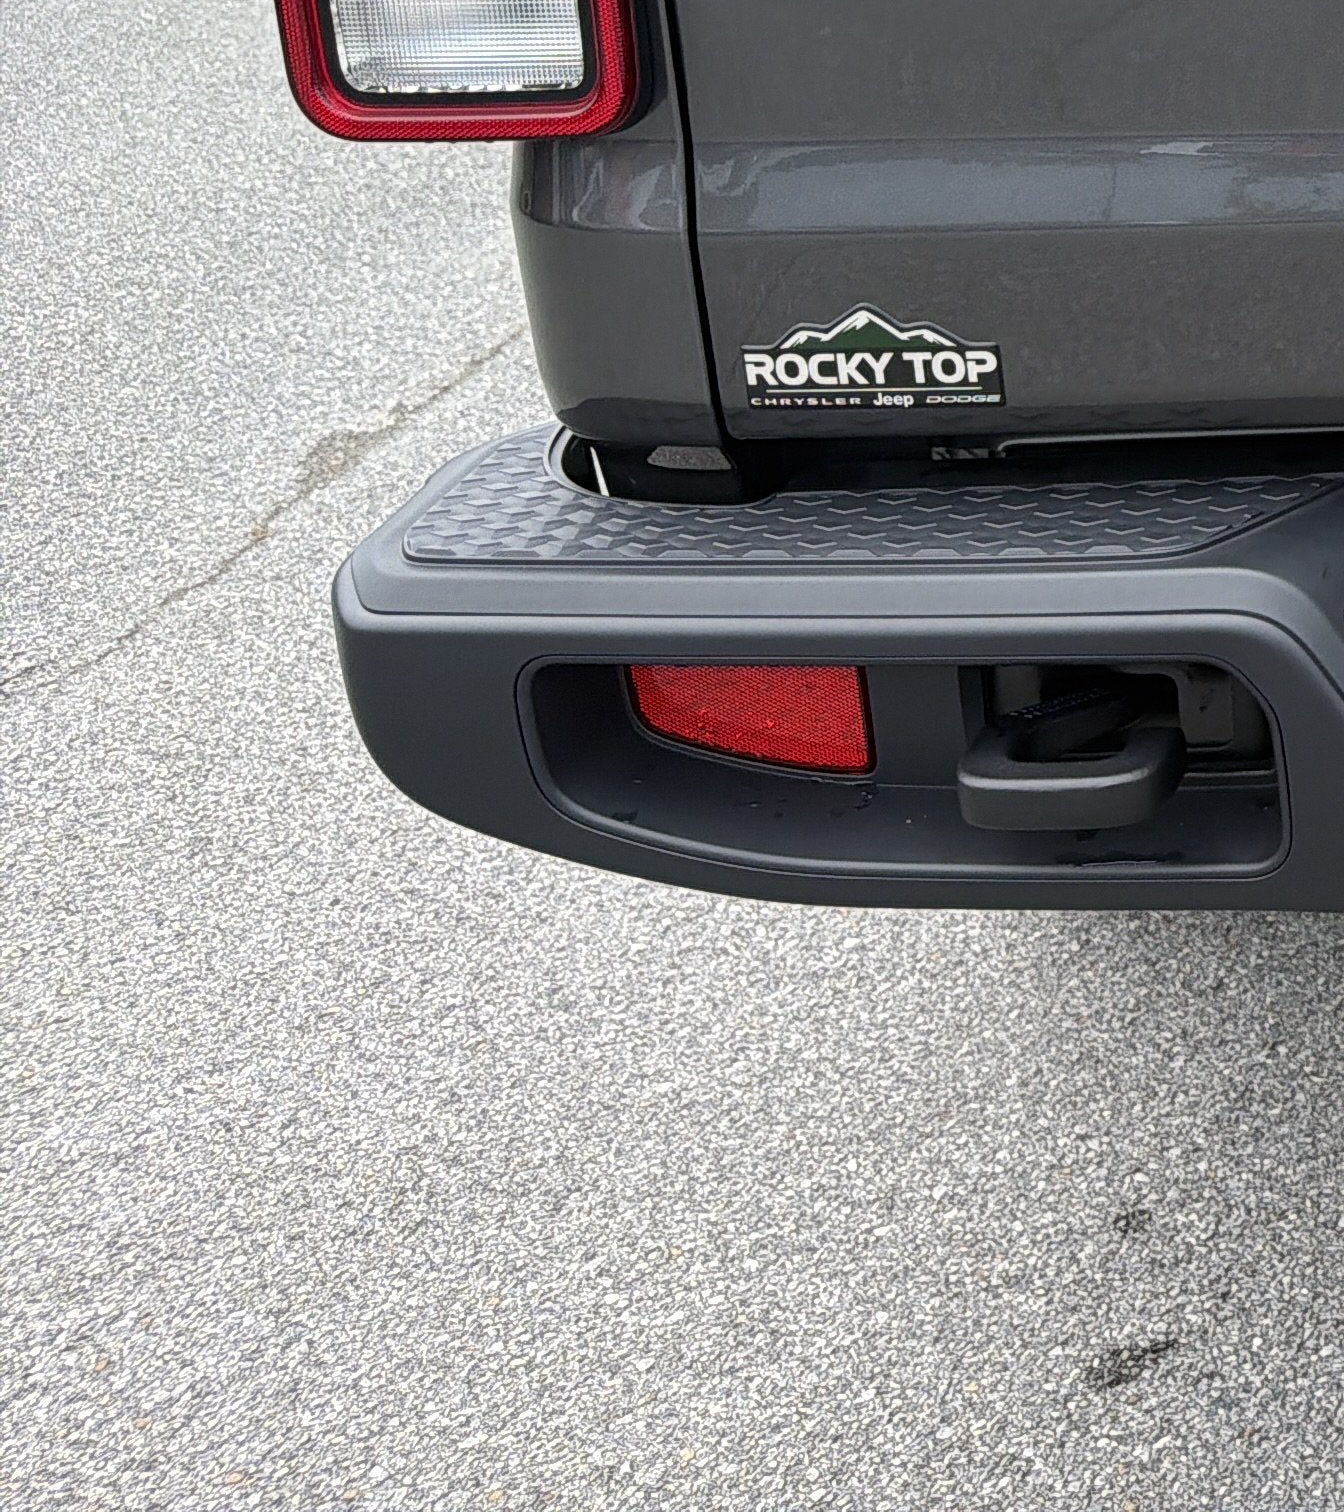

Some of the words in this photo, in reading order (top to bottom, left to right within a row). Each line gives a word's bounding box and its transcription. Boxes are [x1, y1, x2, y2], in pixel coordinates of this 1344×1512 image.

[744, 352, 894, 386] ROCKY
[902, 350, 998, 384] TOP
[751, 396, 861, 406] CHRYSLER
[873, 393, 914, 408] Jeep
[925, 394, 1001, 403] DODGE
